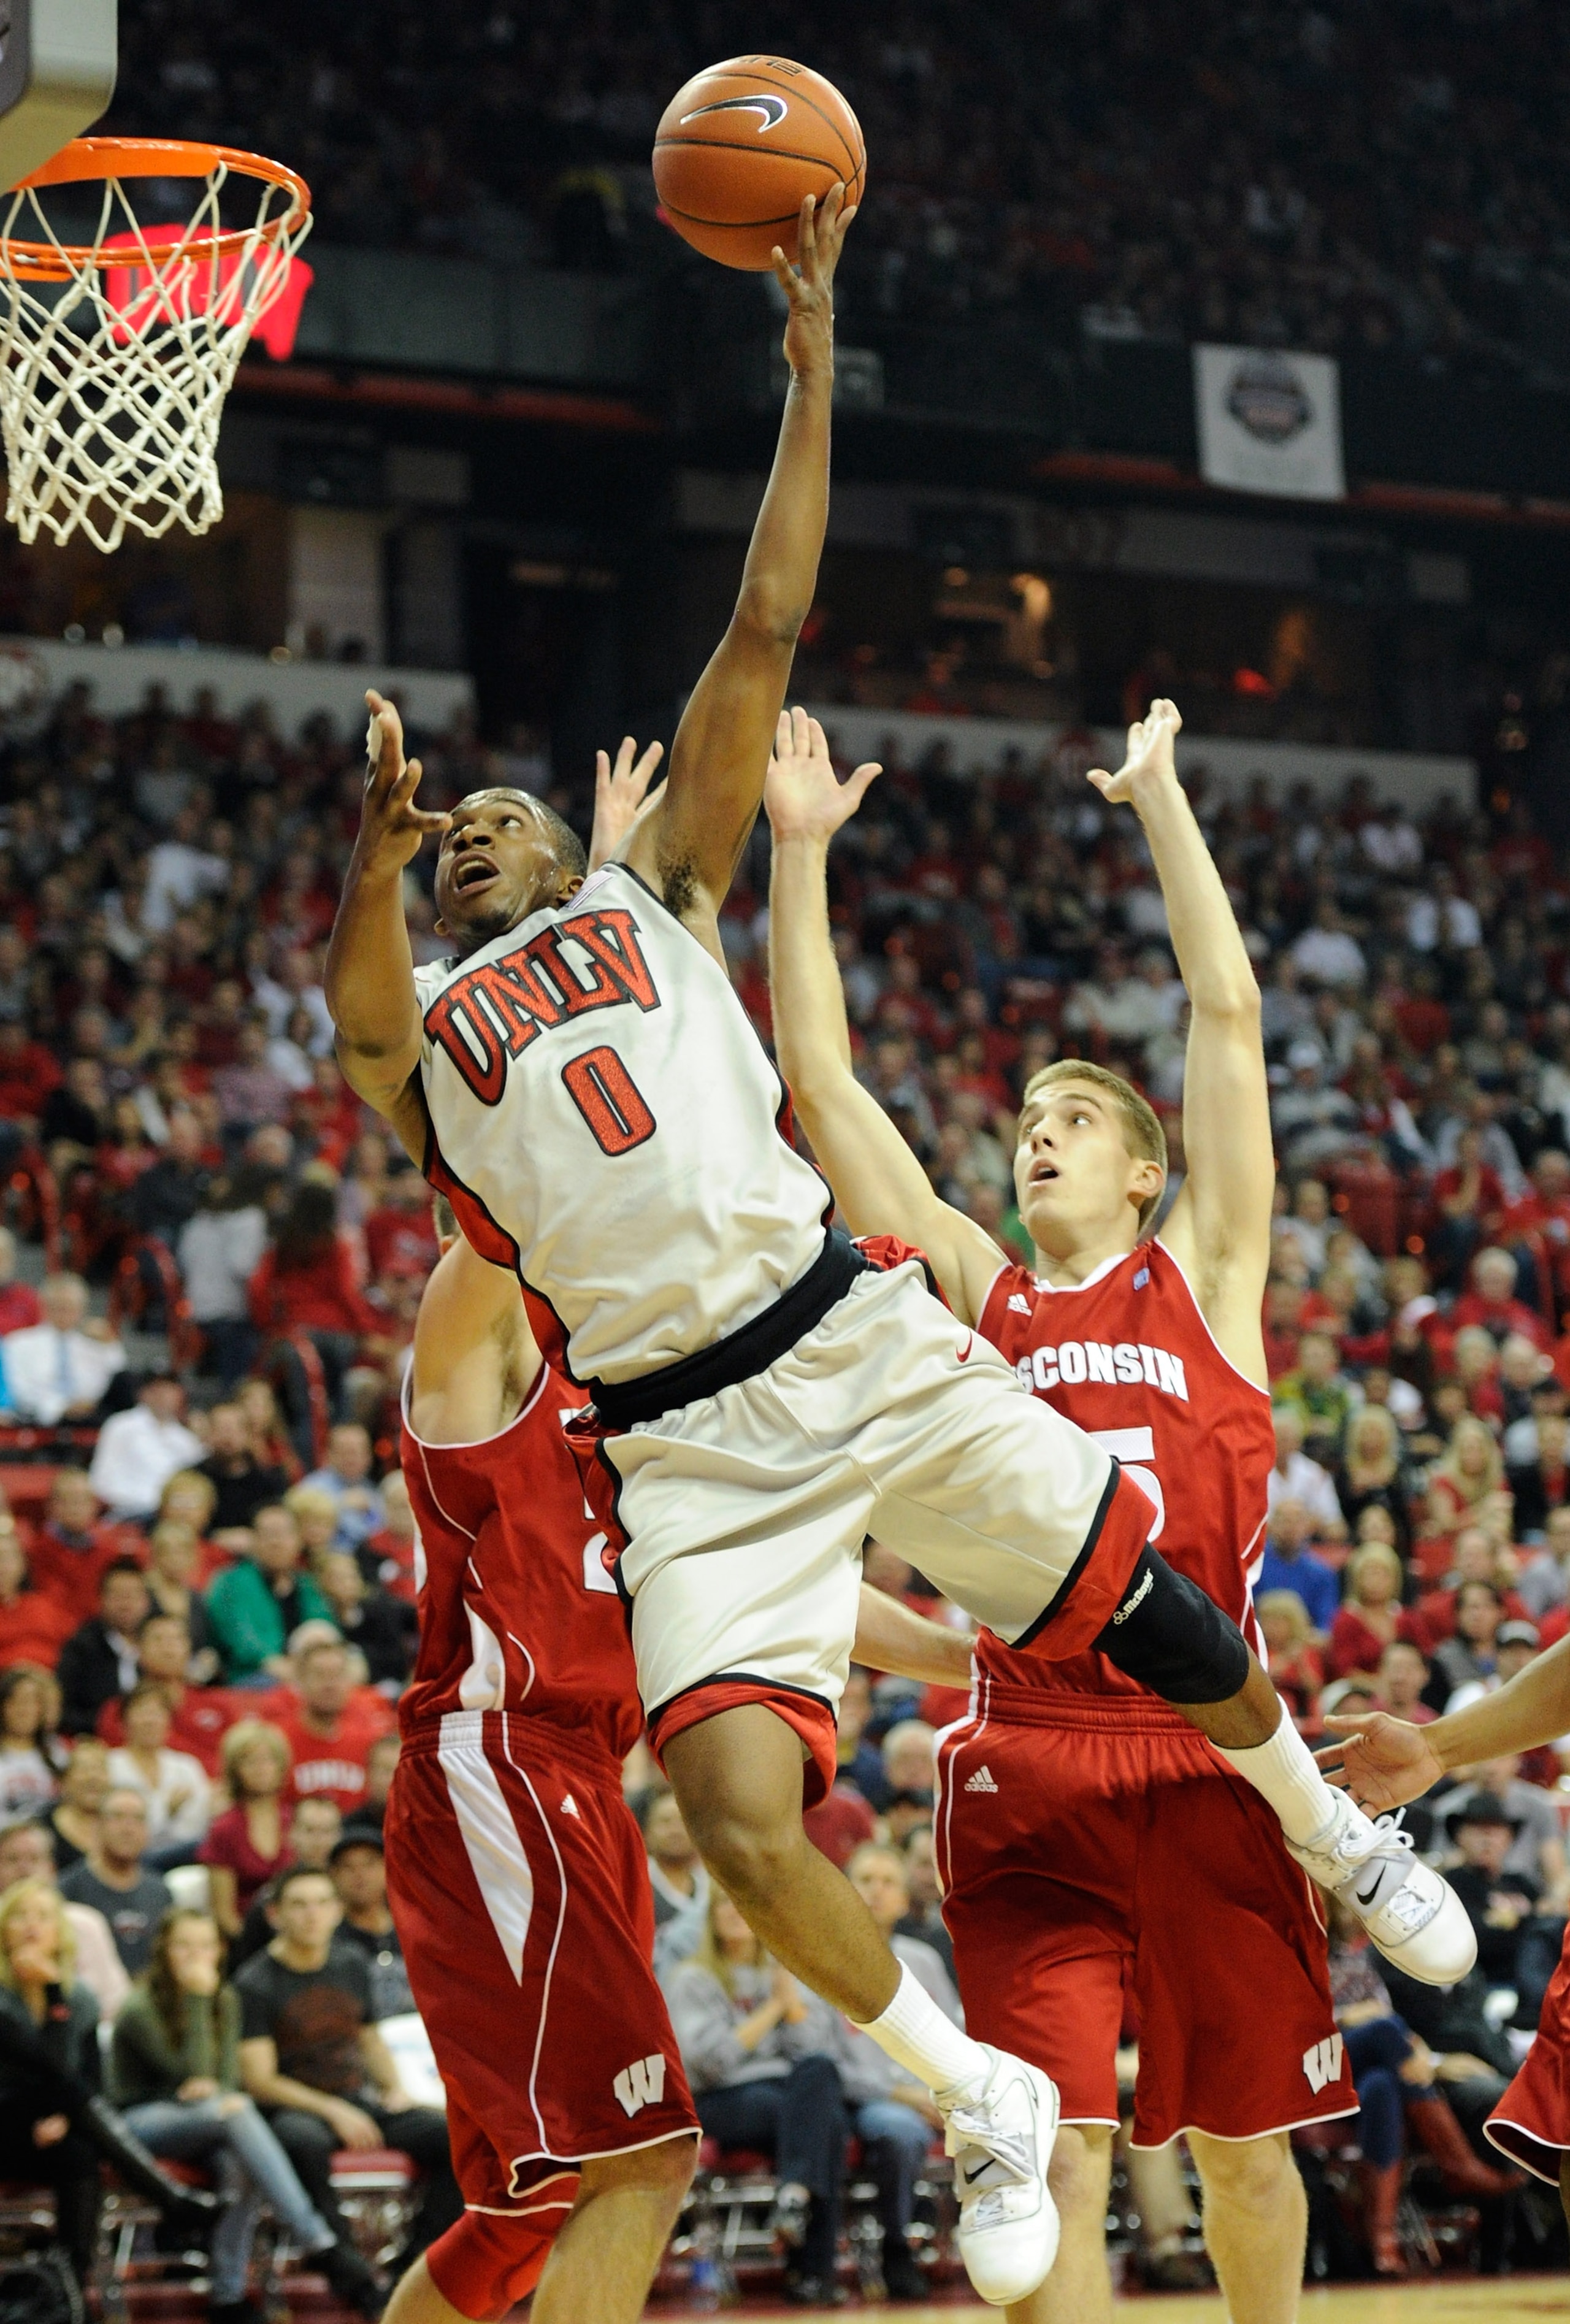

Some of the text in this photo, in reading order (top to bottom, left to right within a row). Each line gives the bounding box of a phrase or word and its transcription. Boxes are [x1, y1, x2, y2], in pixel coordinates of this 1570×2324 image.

[424, 909, 661, 1106] UNLV
[561, 1045, 657, 1157] 0
[1011, 1341, 1189, 1403] SCONSIN
[963, 1782, 999, 1793] adidas
[613, 2053, 667, 2119] W
[1303, 2031, 1344, 2096] W
